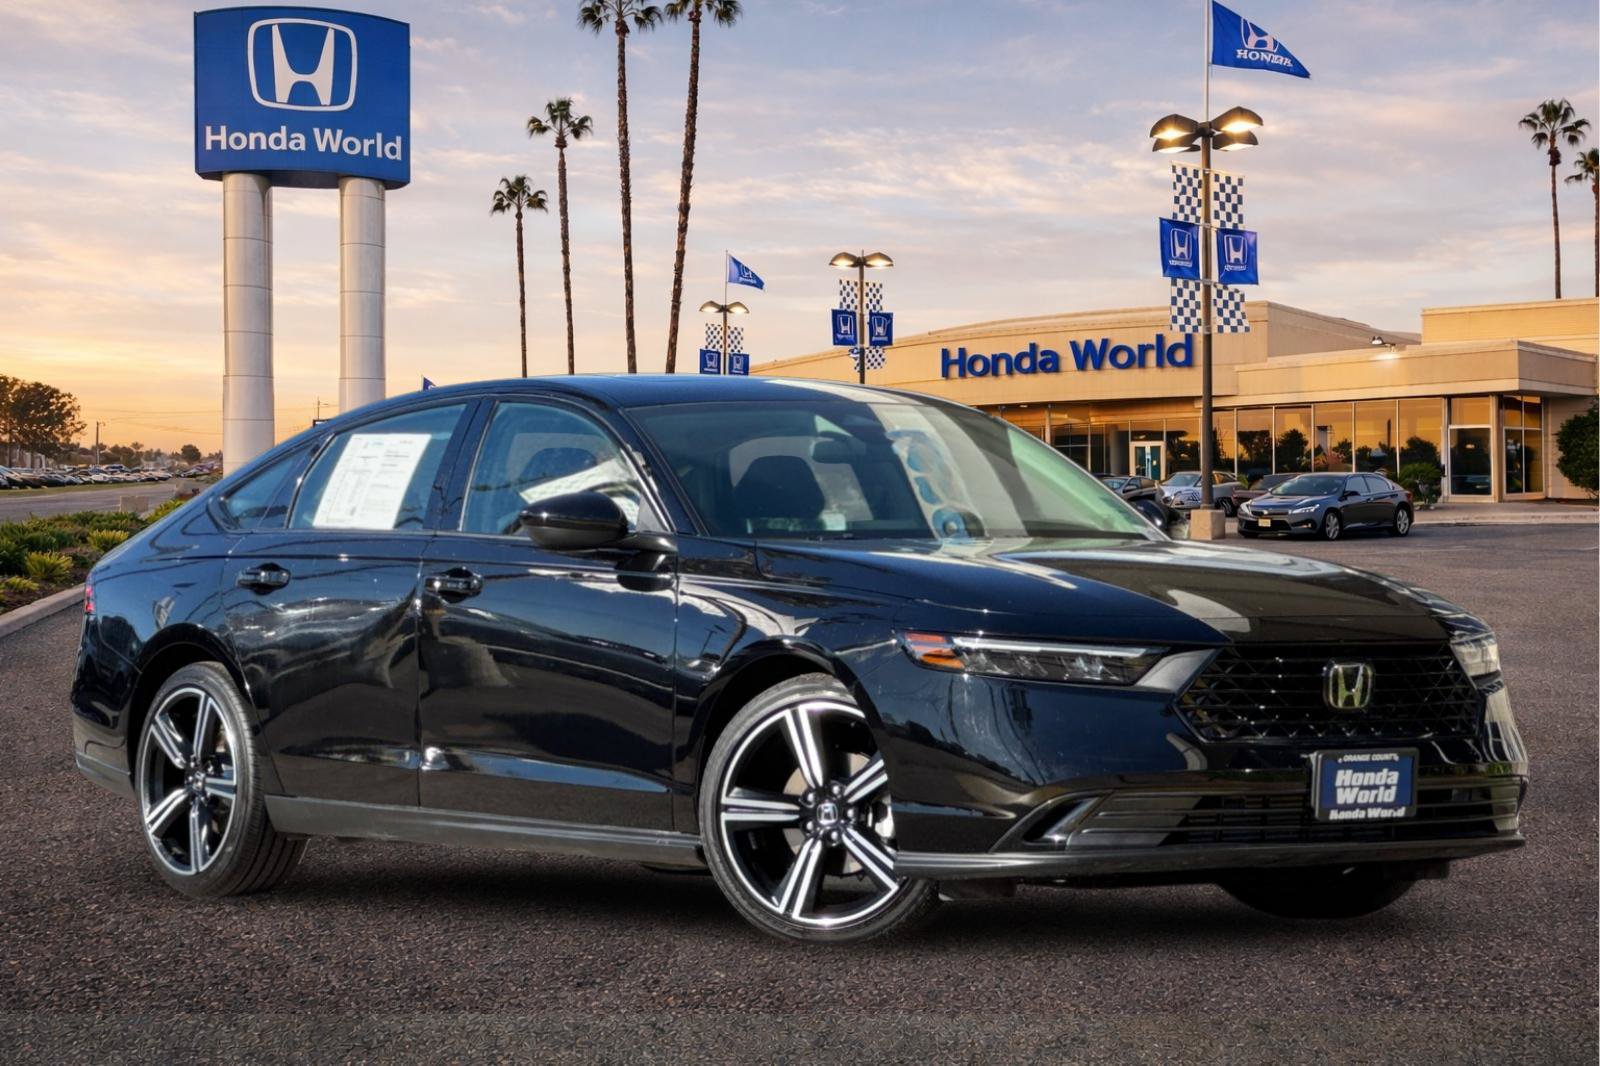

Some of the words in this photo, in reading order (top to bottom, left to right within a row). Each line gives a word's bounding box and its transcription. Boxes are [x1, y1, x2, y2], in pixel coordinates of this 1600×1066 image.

[205, 125, 306, 151] Honda
[313, 127, 402, 161] World
[941, 342, 1060, 380] Honda
[1069, 333, 1195, 371] World
[1335, 768, 1399, 787] Honda
[1336, 785, 1397, 805] World
